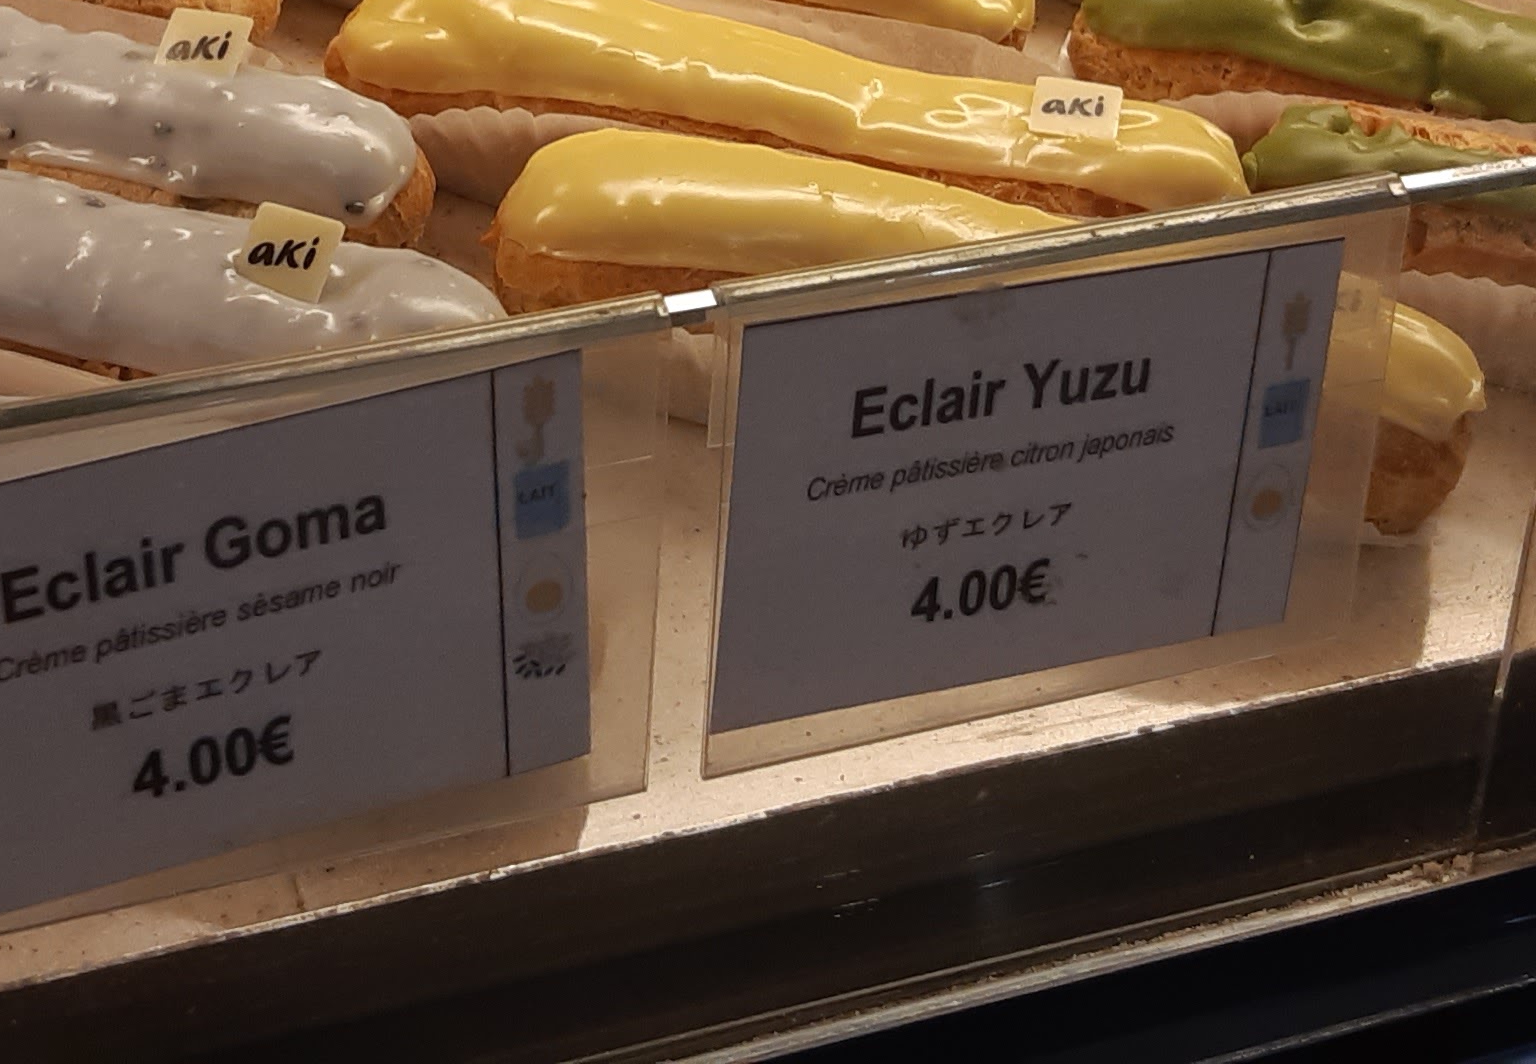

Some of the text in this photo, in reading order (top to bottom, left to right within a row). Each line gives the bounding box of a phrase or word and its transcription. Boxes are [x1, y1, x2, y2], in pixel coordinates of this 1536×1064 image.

[168, 31, 232, 60] aki
[1042, 96, 1104, 117] aki
[248, 237, 319, 270] aki
[851, 357, 1151, 438] Eclair Yuzu
[807, 422, 1175, 501] Crème pâtissière citron japonais
[0, 495, 386, 624] Eclair Goma
[900, 502, 1072, 549] ゆずエクレア
[94, 610, 227, 665] pâtissière
[237, 578, 340, 621] sésame
[350, 561, 401, 594] noir
[910, 557, 1051, 622] 4.00€
[133, 714, 294, 798] 4.00€
